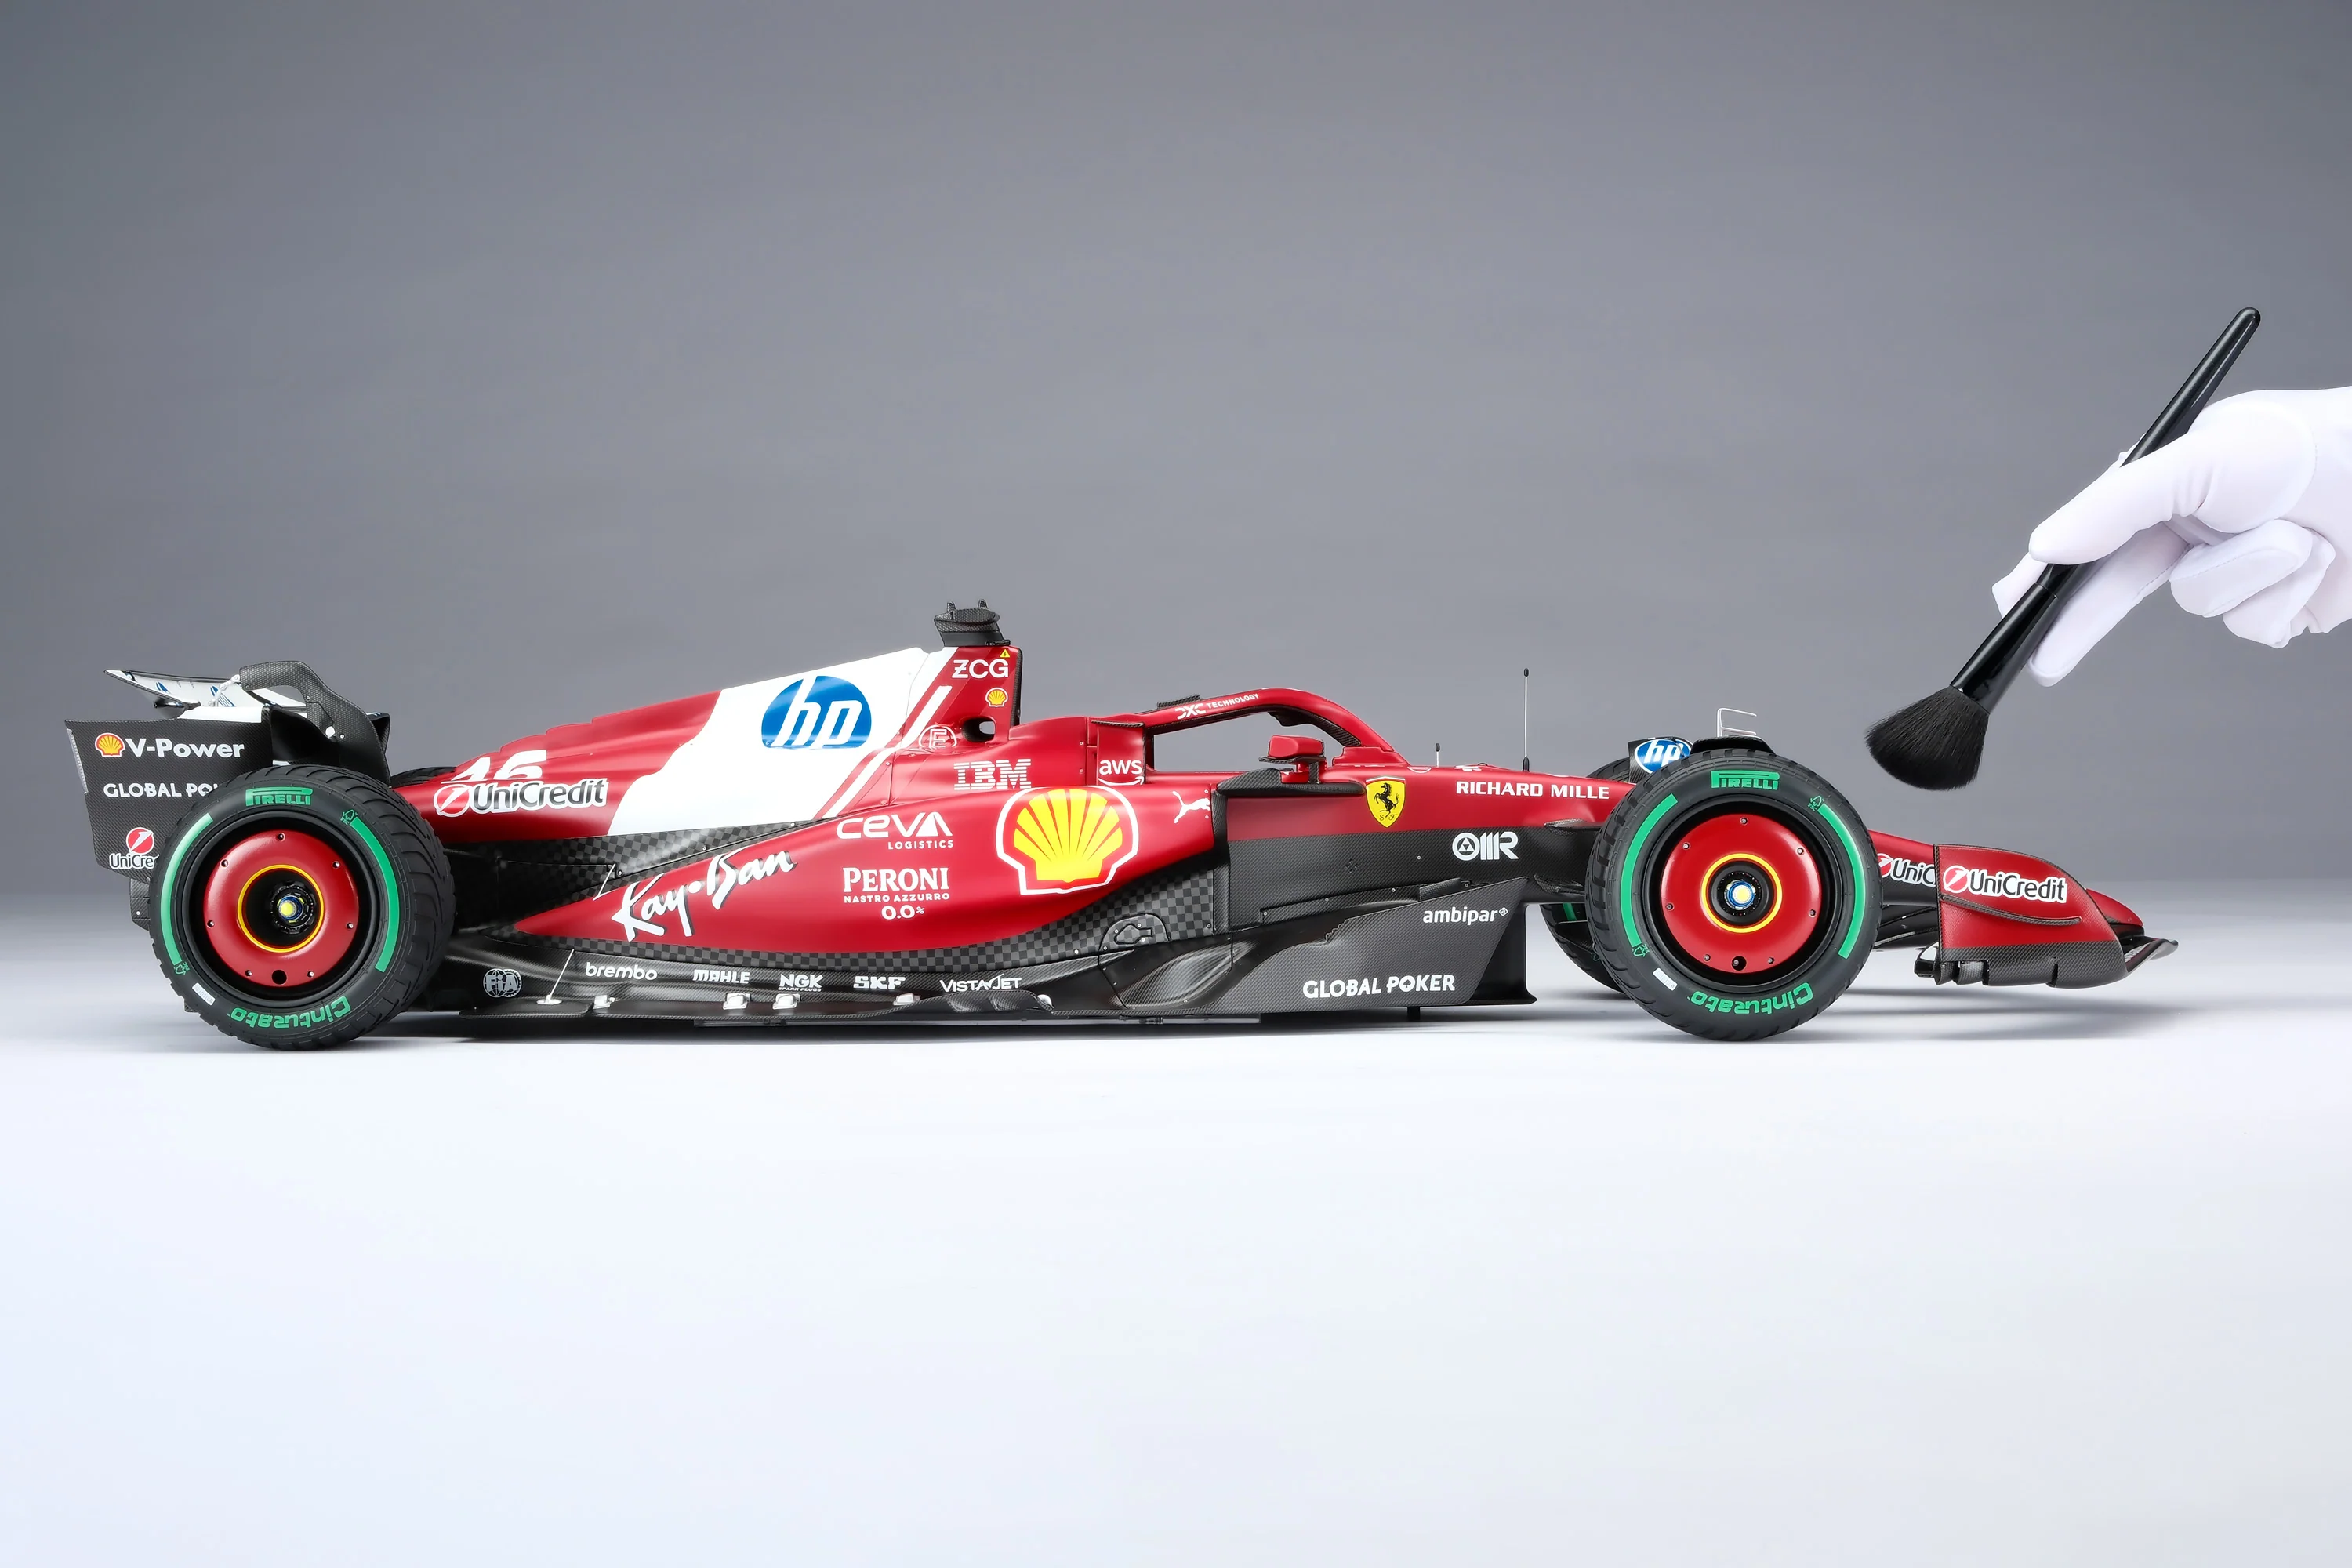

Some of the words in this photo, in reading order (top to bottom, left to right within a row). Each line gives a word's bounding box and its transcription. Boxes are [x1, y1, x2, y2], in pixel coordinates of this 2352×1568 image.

[771, 676, 863, 750] hp
[1174, 703, 1207, 720] DXC
[1207, 693, 1259, 710] TECHNOLOGY
[125, 738, 245, 757] V-Power
[953, 758, 1032, 790] IBM
[1099, 760, 1143, 775] aws
[103, 782, 181, 797] GLOBAL
[186, 783, 218, 797] PO
[1711, 770, 1780, 790] PIRELLI
[245, 786, 313, 807] PIRELLI
[473, 779, 605, 811] UniCredit
[1456, 781, 1543, 797] RICHARD
[1551, 784, 1610, 800] MILLE
[887, 840, 954, 850] LOGISTICS
[110, 853, 156, 869] UniCre
[843, 867, 949, 892] PERONI
[1892, 858, 1935, 885] UniC
[1970, 871, 2066, 901] UniCredit
[844, 895, 891, 903] NASTRO
[894, 892, 950, 902] AZZURRO
[1423, 906, 1498, 925] ambipar
[585, 962, 658, 980] brembo
[693, 969, 750, 984] MAHLE
[779, 974, 824, 988] NGK
[853, 975, 906, 989] SKF
[1302, 977, 1381, 999] GLOBAL
[1386, 975, 1456, 993] POKER
[1690, 982, 1814, 1014] Cinturato
[230, 996, 351, 1029] Cinturato
